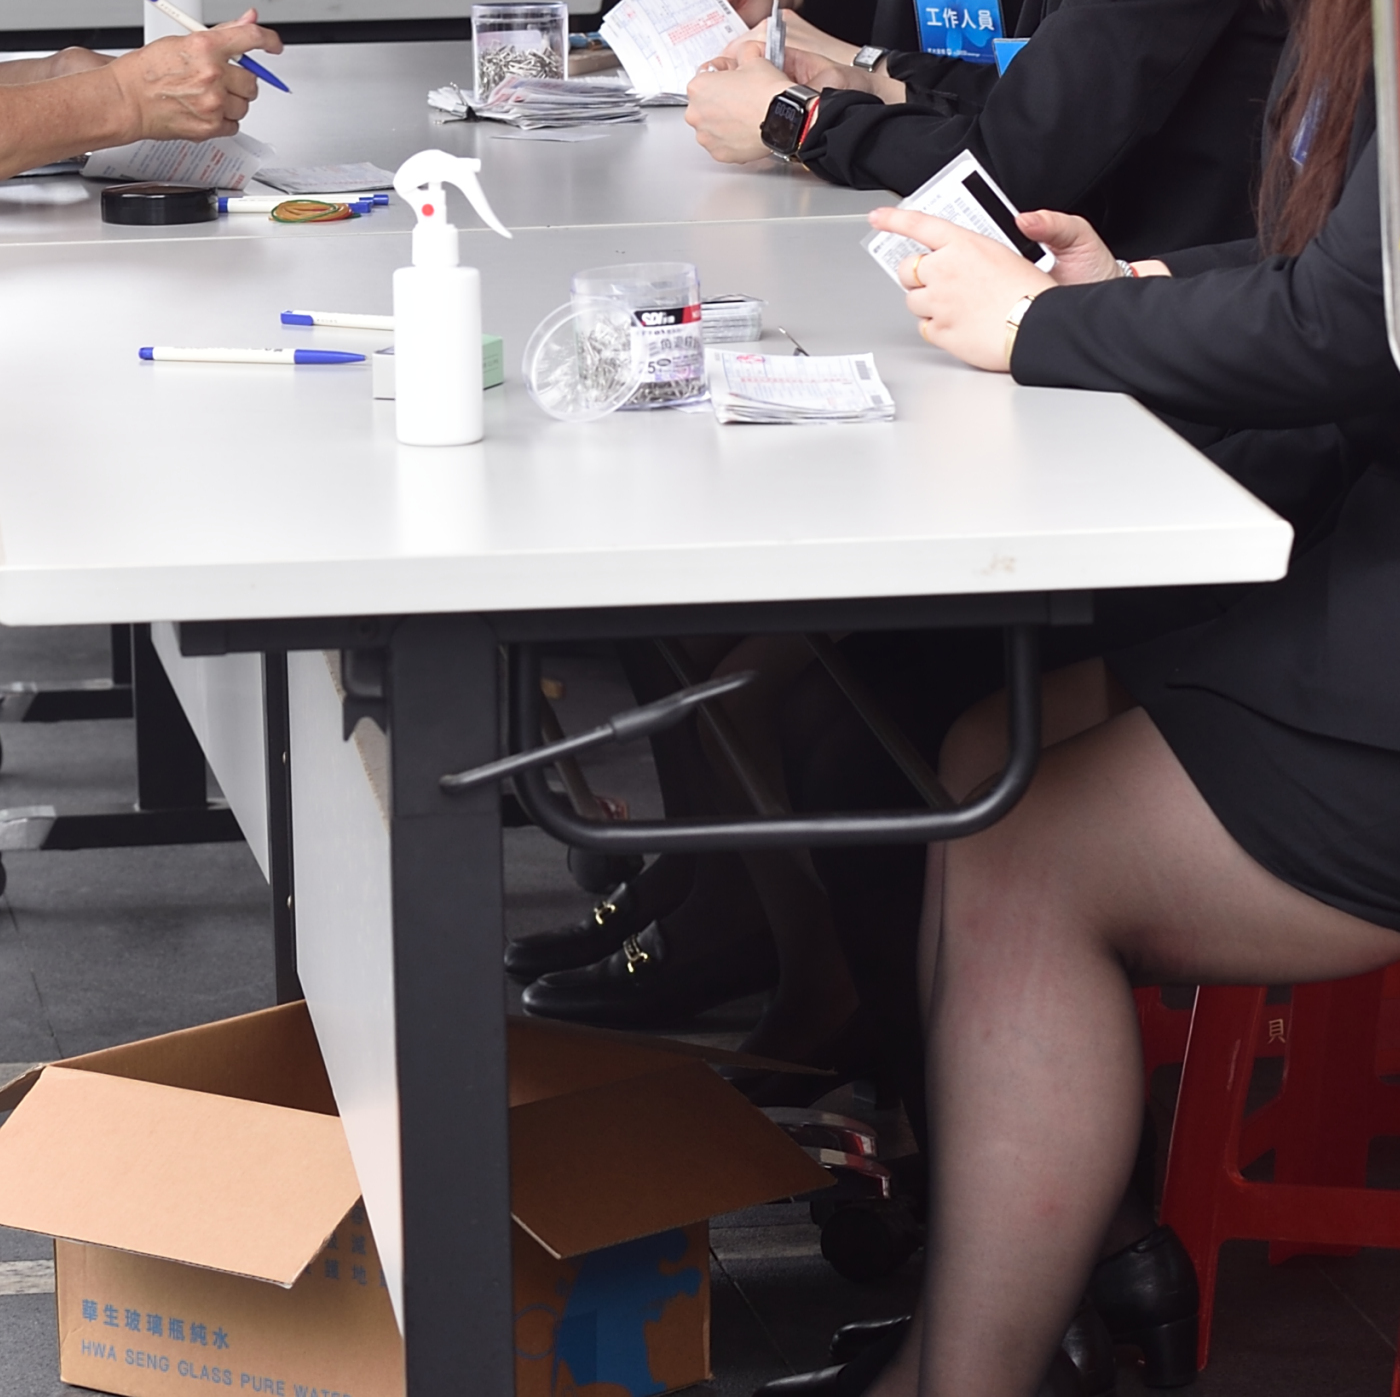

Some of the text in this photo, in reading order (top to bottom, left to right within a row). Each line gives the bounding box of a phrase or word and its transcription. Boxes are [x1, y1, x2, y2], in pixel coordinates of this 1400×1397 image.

[925, 7, 995, 31] 工作人員
[81, 1298, 230, 1350] 華生玻璃瓶純水
[81, 1338, 117, 1362] HWA
[125, 1348, 170, 1373] SENG
[177, 1359, 233, 1386] GLASS
[240, 1372, 286, 1397] PURE
